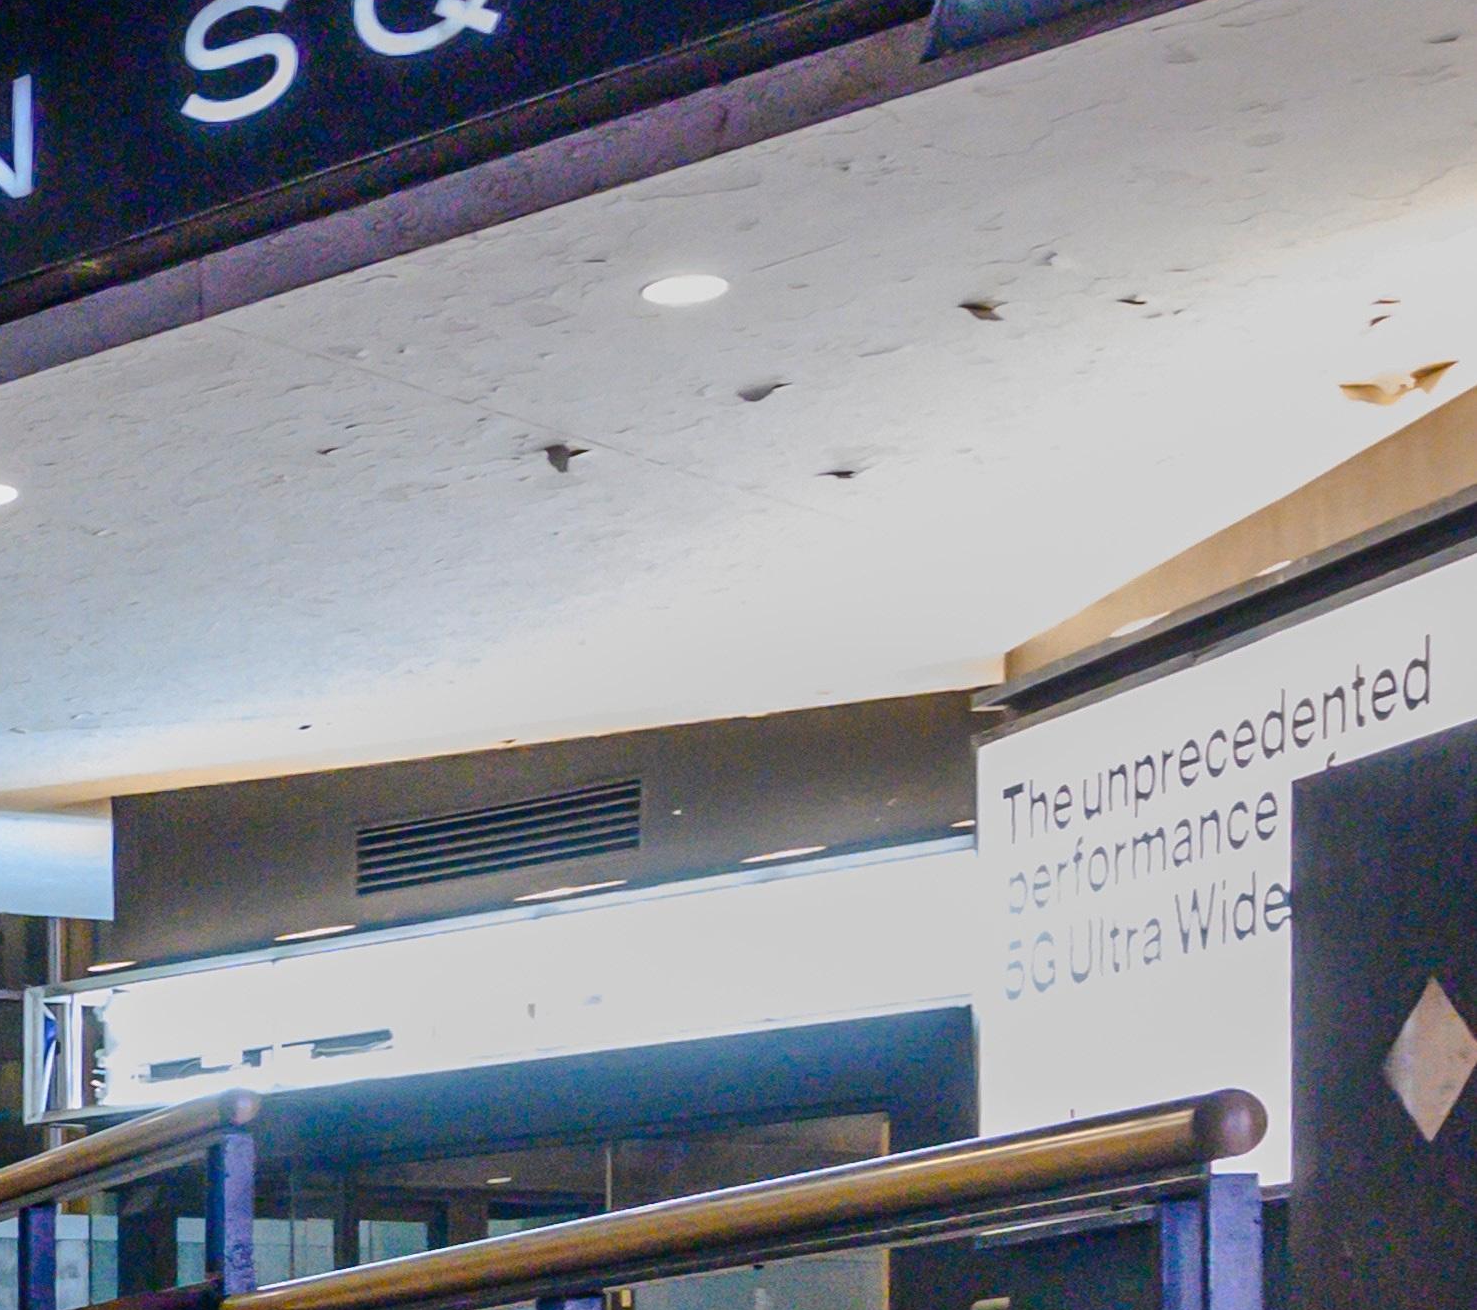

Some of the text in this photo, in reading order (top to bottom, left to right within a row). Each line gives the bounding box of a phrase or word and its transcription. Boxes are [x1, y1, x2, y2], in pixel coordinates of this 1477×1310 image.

[1002, 633, 1433, 846] The unprecedented
[1008, 790, 1280, 915] performance
[1004, 929, 1057, 1002] 5G
[1069, 915, 1164, 984] Ultra
